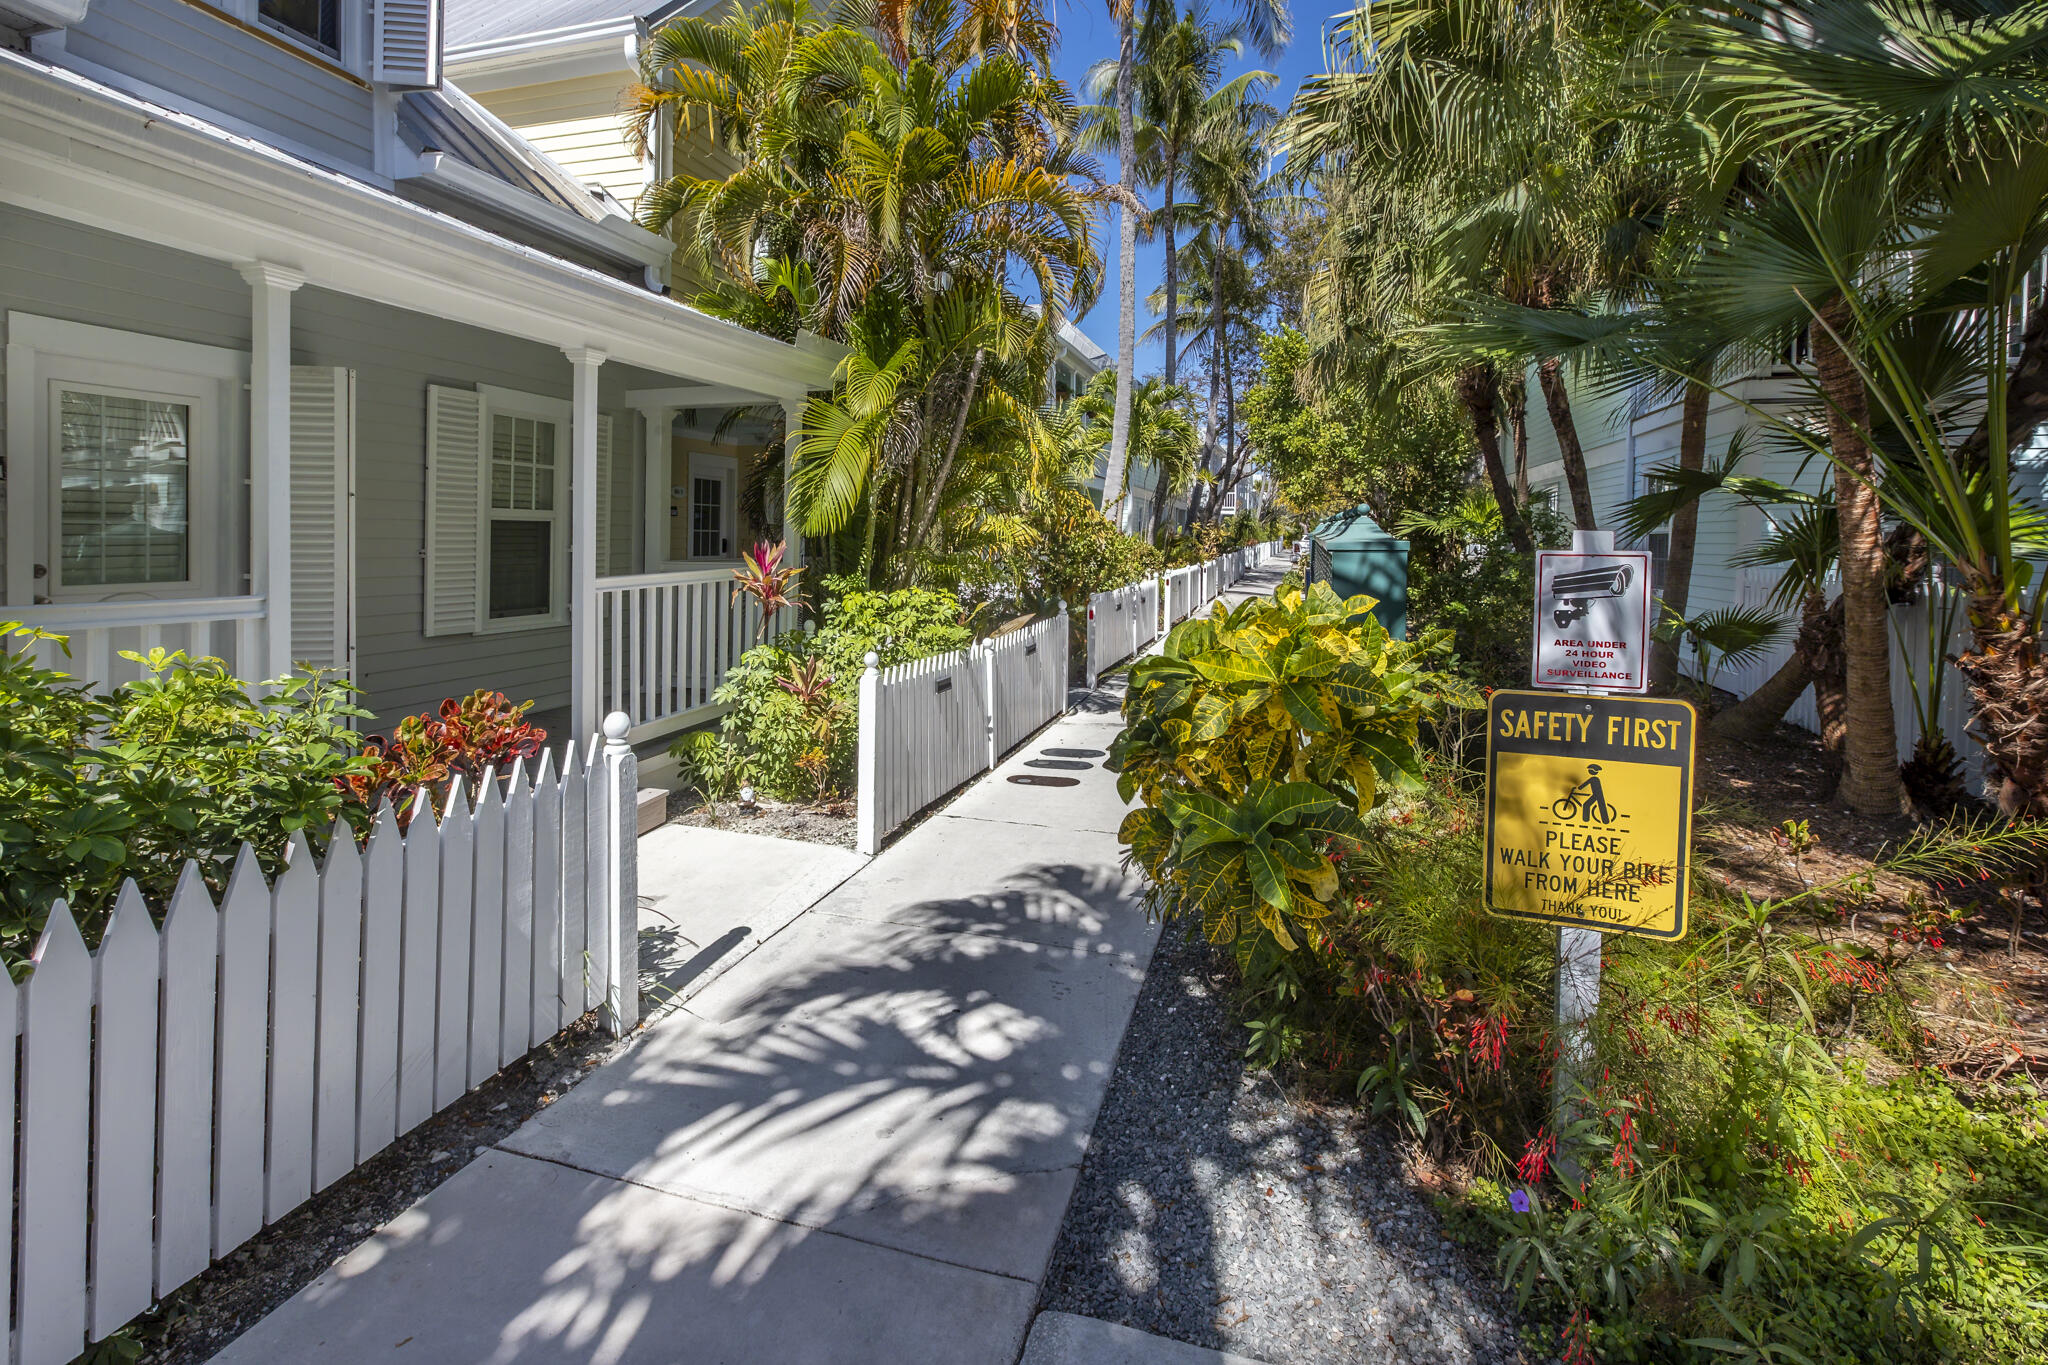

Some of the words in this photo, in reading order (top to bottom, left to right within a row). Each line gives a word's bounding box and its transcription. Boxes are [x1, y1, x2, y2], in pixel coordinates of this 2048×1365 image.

[1554, 639, 1584, 647] AREA
[1587, 640, 1627, 649] UNDER
[1565, 649, 1578, 657] 24
[1582, 650, 1614, 659] HOUR
[1547, 668, 1632, 680] SURVEILLANCE
[1572, 660, 1607, 668] VIDEO
[1500, 709, 1594, 743] SAFETY
[1607, 715, 1682, 750] FIRST
[1545, 830, 1621, 856] PLEASE
[1500, 847, 1550, 869] WALK
[1560, 853, 1615, 877] YOUR
[1623, 861, 1670, 885] BIKE
[1524, 871, 1577, 894] FROM
[1587, 879, 1641, 903] HERE
[1541, 899, 1584, 914] THANK
[1590, 905, 1622, 921] YOU!
